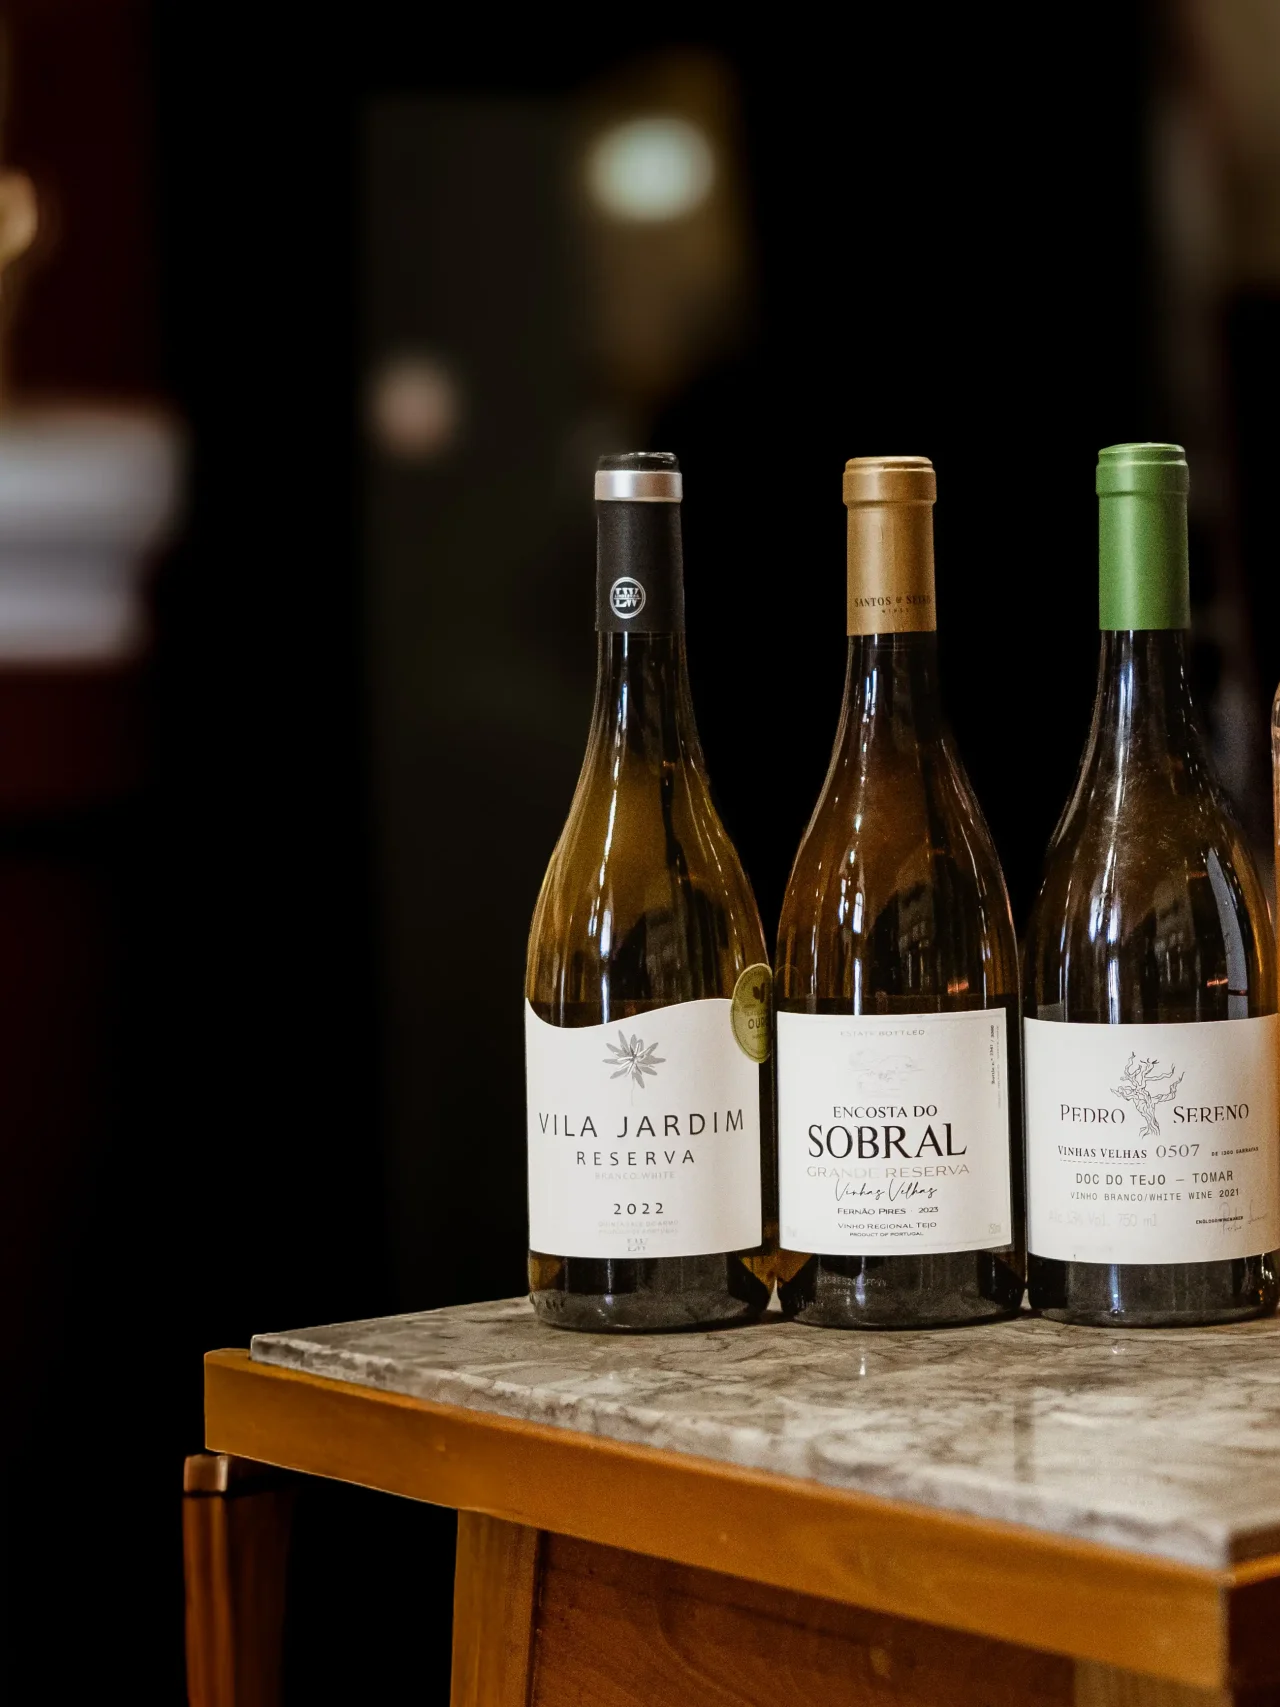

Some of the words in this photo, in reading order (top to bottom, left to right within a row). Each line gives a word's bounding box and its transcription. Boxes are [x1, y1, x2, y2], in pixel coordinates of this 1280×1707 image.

[854, 596, 892, 608] SANTOS
[878, 1029, 926, 1037] BOTTLED
[833, 1106, 908, 1119] ENCOSTA
[913, 1104, 938, 1118] DO
[1060, 1104, 1126, 1124] PEDRO
[1173, 1103, 1249, 1124] SERENO
[538, 1112, 598, 1138] VILA
[616, 1109, 744, 1138] JARDIM
[808, 1123, 968, 1159] SOBRAL
[576, 1149, 695, 1167] RESERVA
[1058, 1145, 1096, 1158] VINHAS
[1100, 1148, 1147, 1159] VELHAS
[1155, 1144, 1200, 1158] 0507
[807, 1166, 880, 1179] GRANDE
[885, 1164, 970, 1178] RESERVA
[1075, 1173, 1100, 1185] DOC
[1106, 1174, 1123, 1186] DO
[1130, 1174, 1166, 1186] TEJO
[1192, 1170, 1234, 1184] TOMAR
[835, 1178, 885, 1201] Vinhas
[888, 1178, 938, 1201] Velhas
[1070, 1191, 1098, 1201] VINHO
[1104, 1191, 1181, 1202] BRANCO/WHITE
[1188, 1191, 1213, 1200] WINE
[1219, 1188, 1239, 1198] 2021
[613, 1202, 664, 1215] 2022
[837, 1207, 876, 1215] FERNÃO
